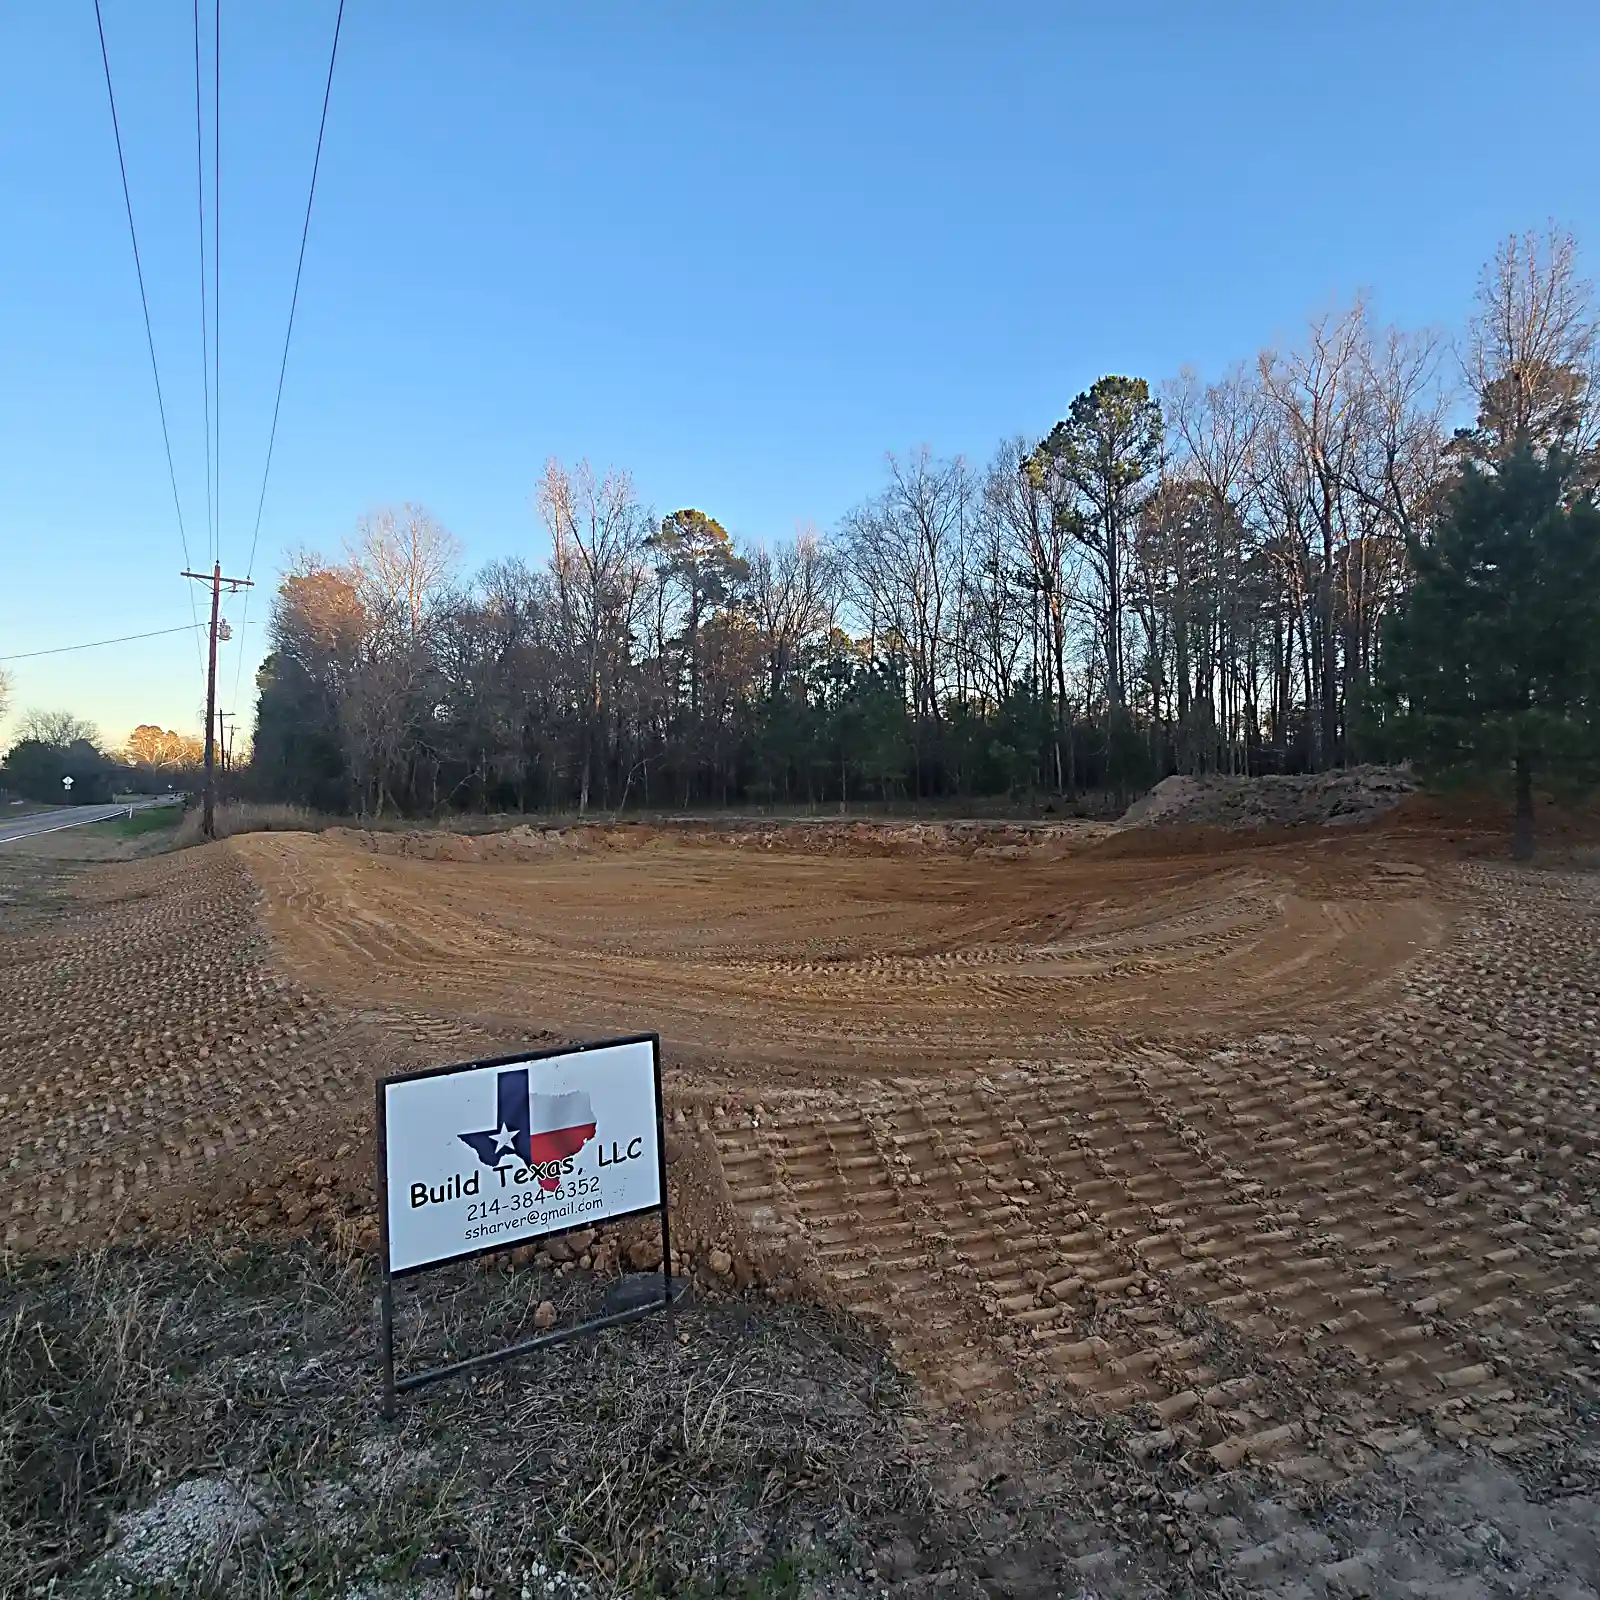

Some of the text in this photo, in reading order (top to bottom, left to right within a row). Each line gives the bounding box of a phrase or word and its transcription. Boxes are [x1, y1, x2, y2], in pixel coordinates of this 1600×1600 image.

[410, 1137, 642, 1208] Build Texas, LLC
[465, 1197, 603, 1240] ssharver@gmail.com
[467, 1176, 600, 1221] 214-384-6352
